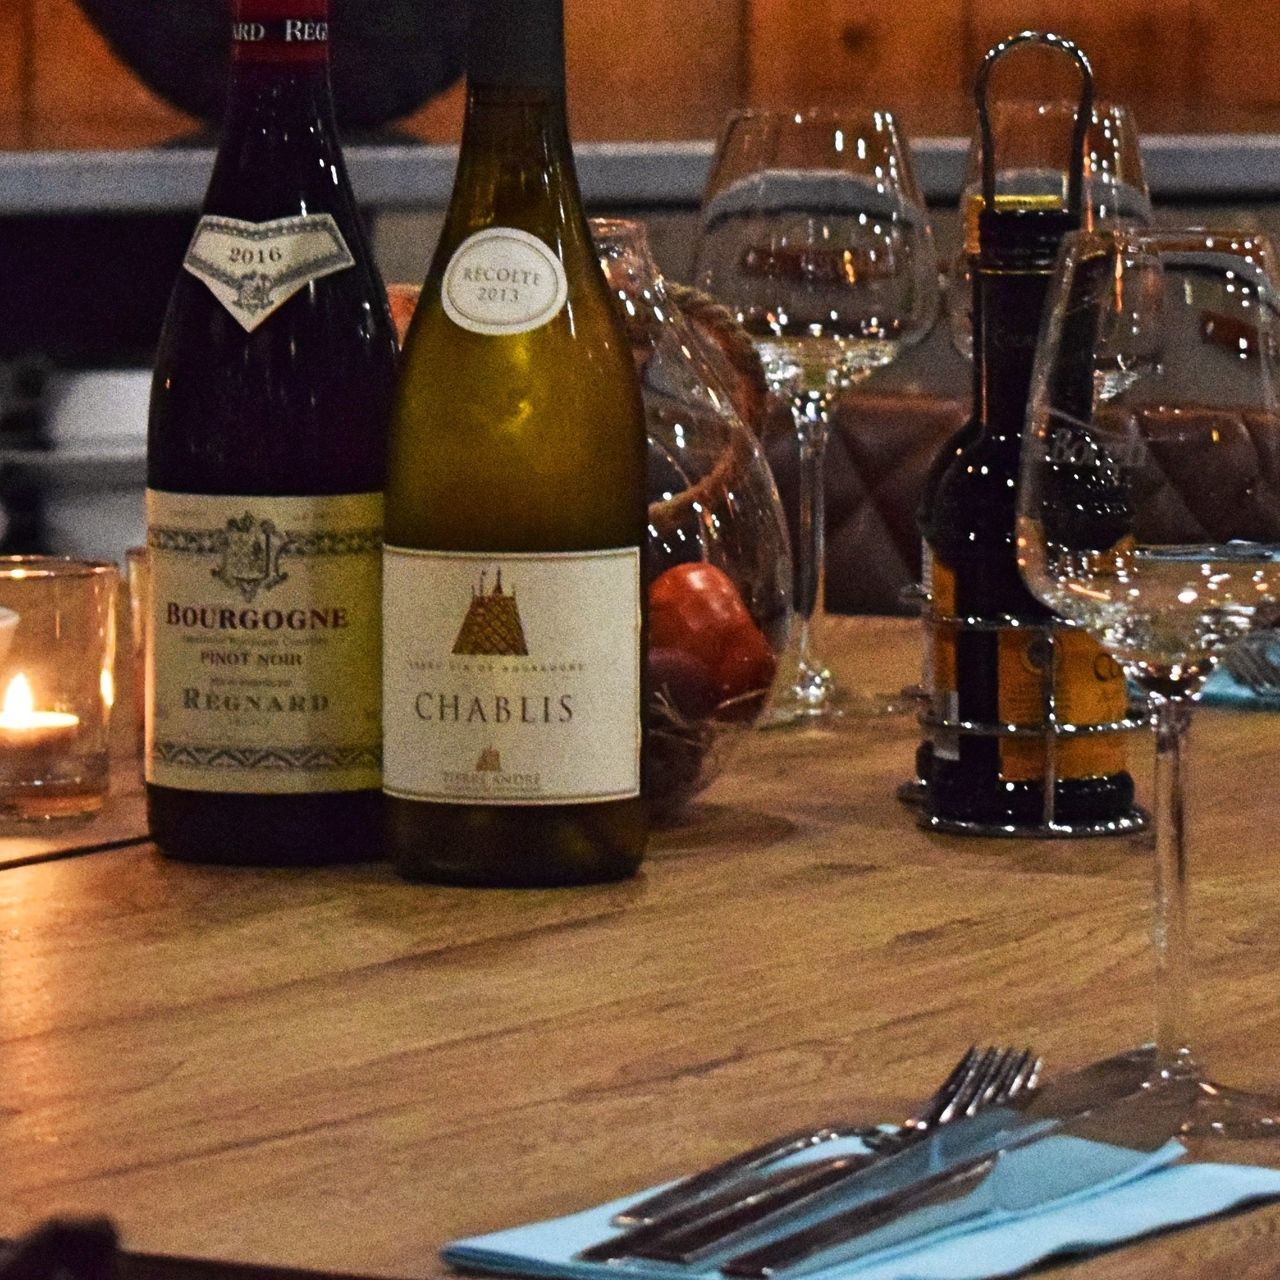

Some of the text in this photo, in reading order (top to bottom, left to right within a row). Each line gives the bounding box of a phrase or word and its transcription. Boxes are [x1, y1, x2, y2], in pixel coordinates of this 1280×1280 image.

[229, 247, 282, 264] 2016
[478, 287, 519, 302] 2013
[166, 602, 348, 630] BOURGOGNE
[200, 650, 302, 666] PINOT NOIR
[415, 691, 574, 723] CHABLIS
